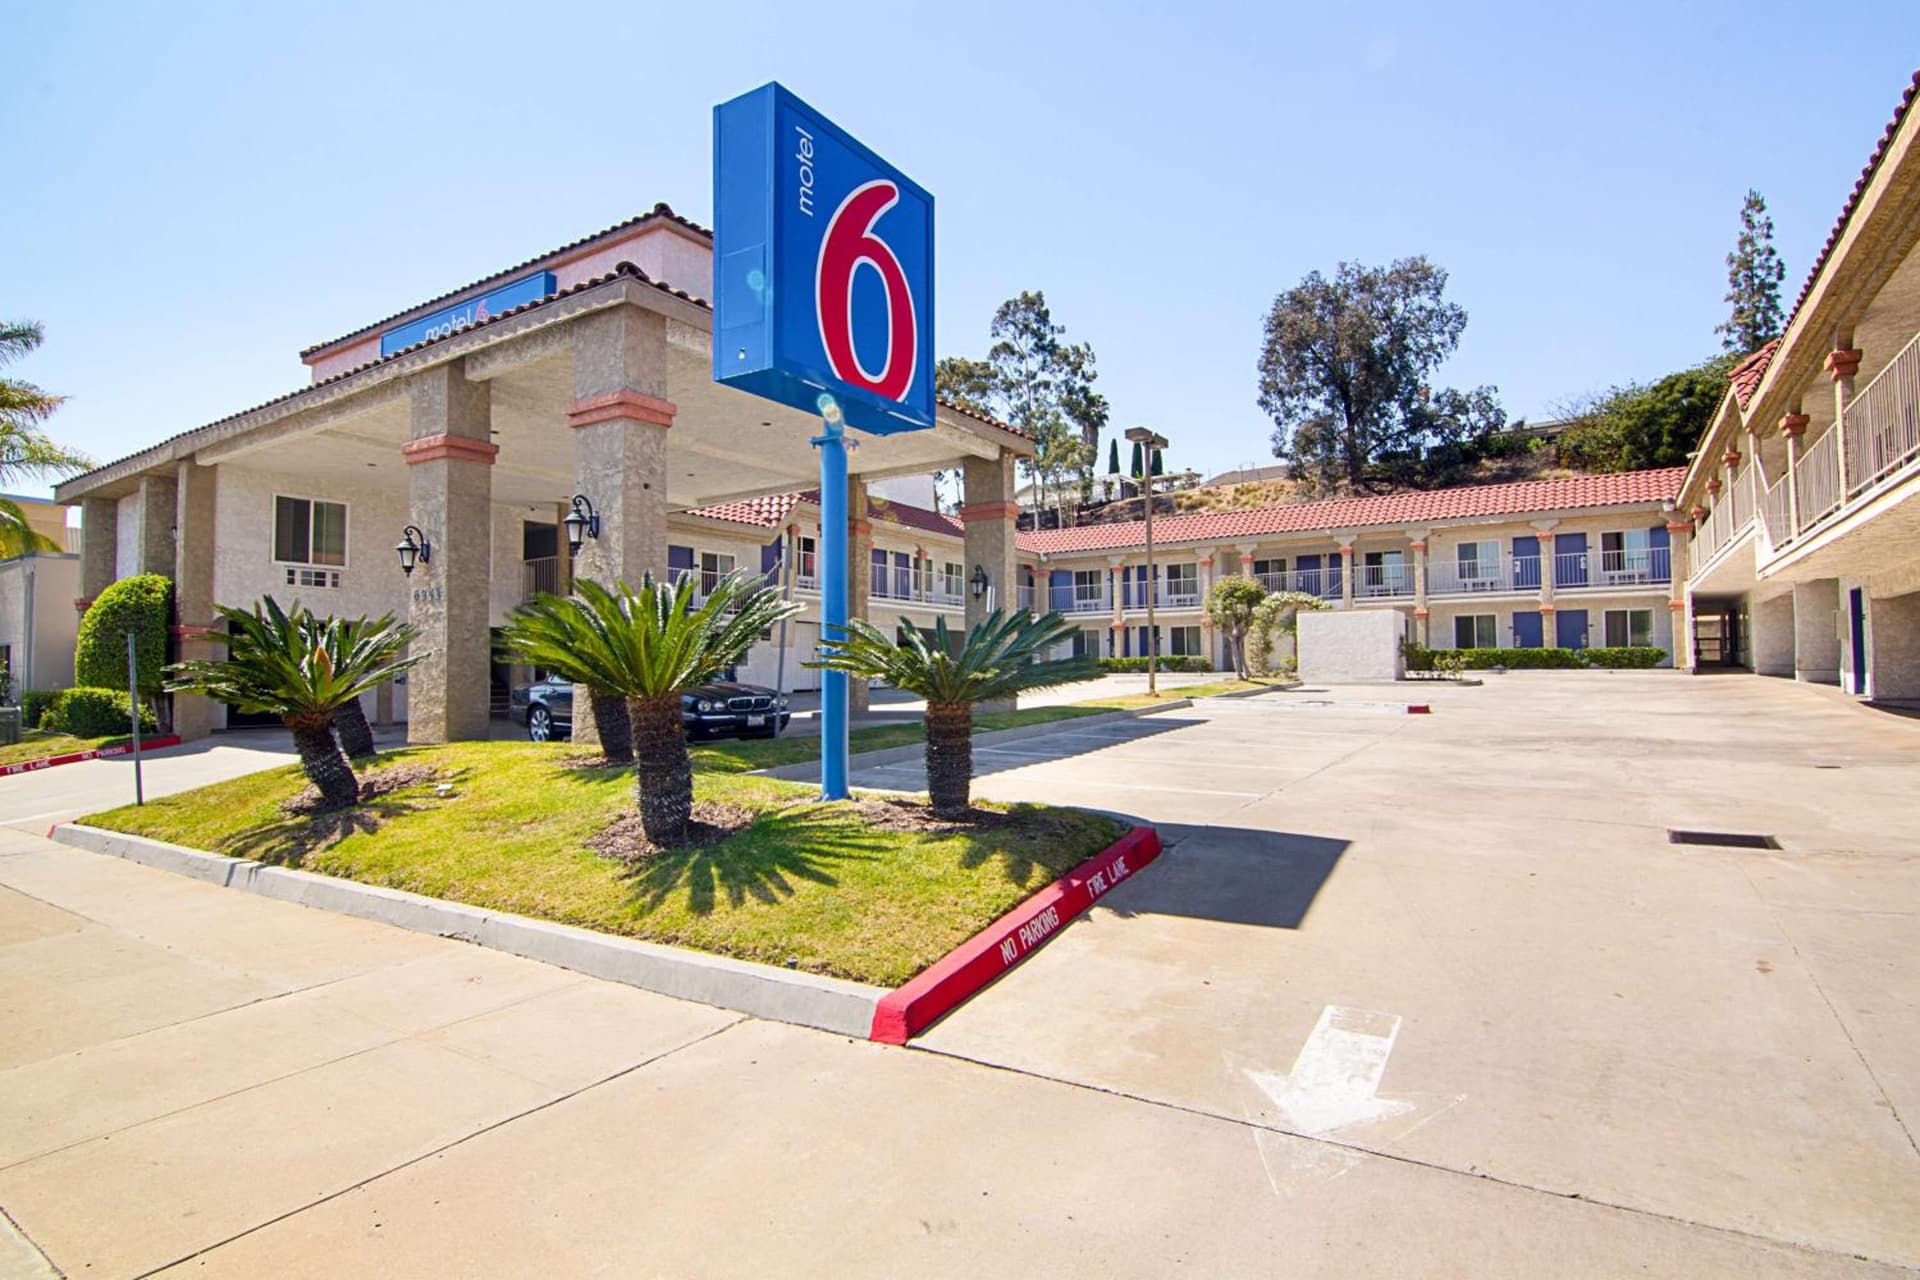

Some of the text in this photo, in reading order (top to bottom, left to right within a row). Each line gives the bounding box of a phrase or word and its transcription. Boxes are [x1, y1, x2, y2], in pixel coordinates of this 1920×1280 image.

[795, 126, 917, 403] motel 6
[425, 299, 490, 339] motel 6
[29, 760, 51, 771] LANE
[1086, 856, 1130, 899] FIRE LANE
[1000, 907, 1060, 965] NO PARKING
